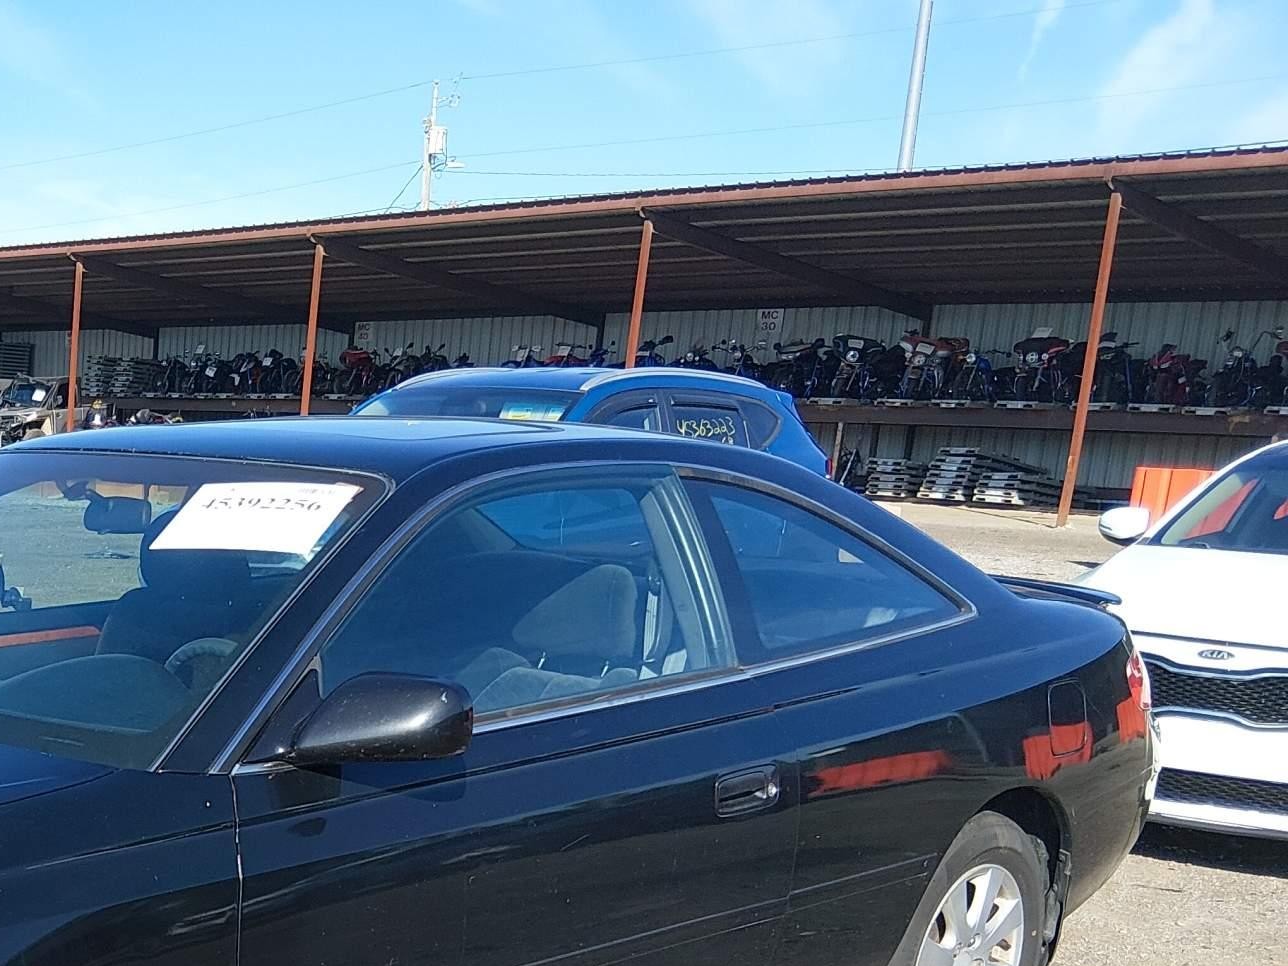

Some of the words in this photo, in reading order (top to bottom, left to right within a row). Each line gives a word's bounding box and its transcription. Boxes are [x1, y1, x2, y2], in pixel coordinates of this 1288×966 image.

[761, 310, 779, 320] MC
[357, 323, 370, 331] MC
[761, 321, 776, 331] 30
[1200, 650, 1229, 660] KIA
